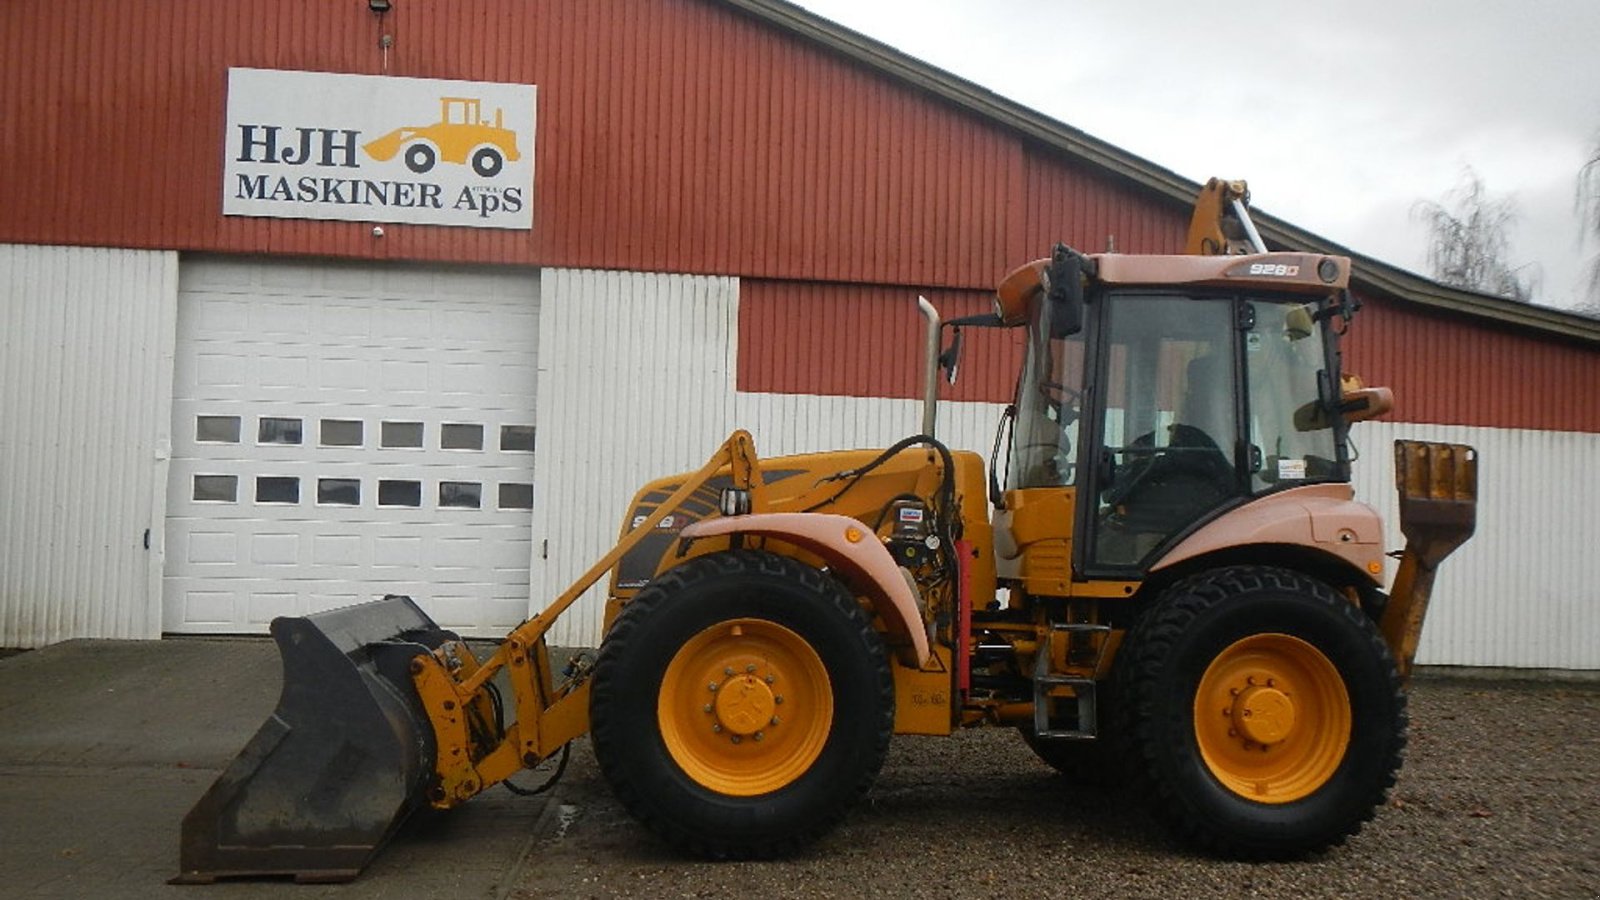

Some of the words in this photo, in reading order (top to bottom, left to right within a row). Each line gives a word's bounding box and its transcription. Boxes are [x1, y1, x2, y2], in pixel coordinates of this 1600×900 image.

[236, 124, 361, 168] HJH
[235, 173, 443, 209] MASKINER
[452, 185, 522, 218] ApS
[1250, 263, 1299, 276] 928D
